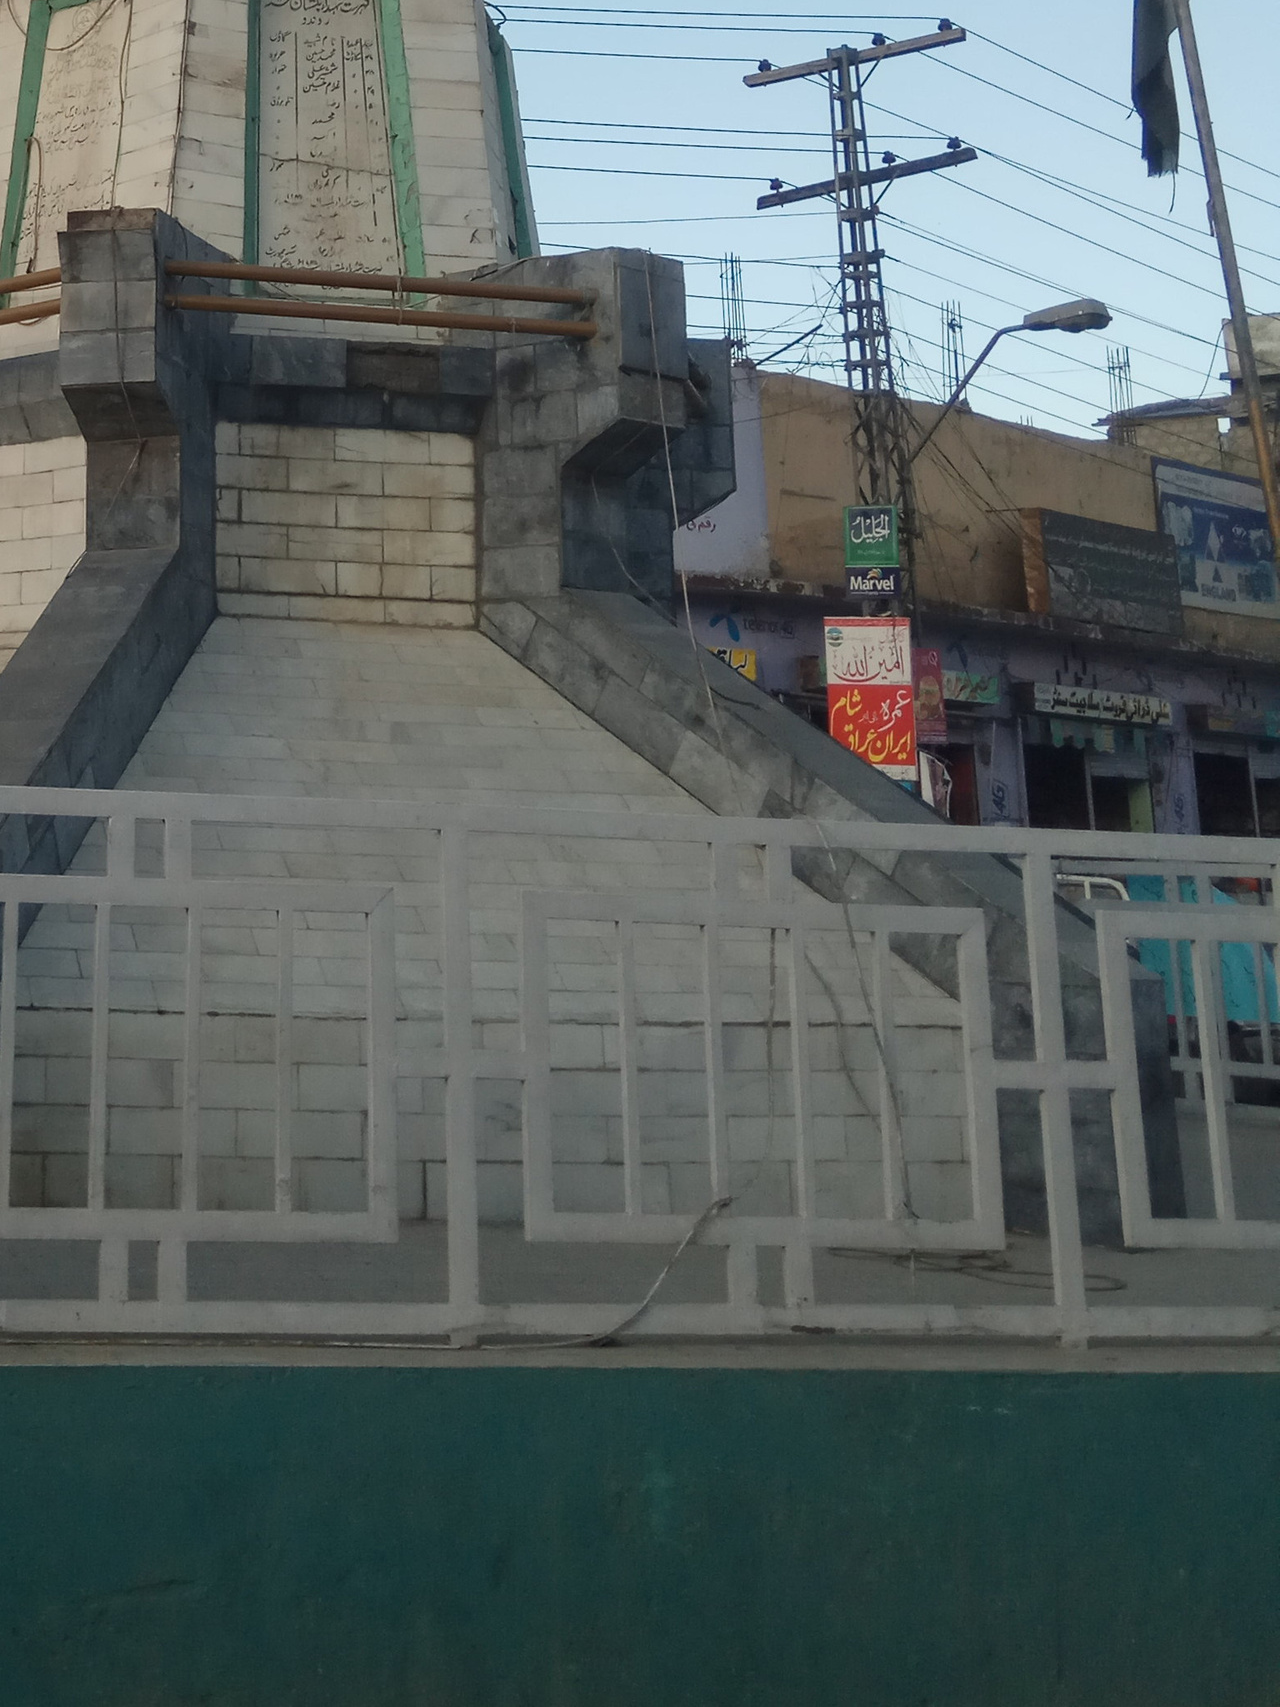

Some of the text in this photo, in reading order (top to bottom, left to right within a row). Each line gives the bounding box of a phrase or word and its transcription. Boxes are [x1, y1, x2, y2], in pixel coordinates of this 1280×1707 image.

[850, 573, 895, 591] Marvel
[830, 689, 863, 736] شام
[844, 723, 912, 763] ایران عراق
